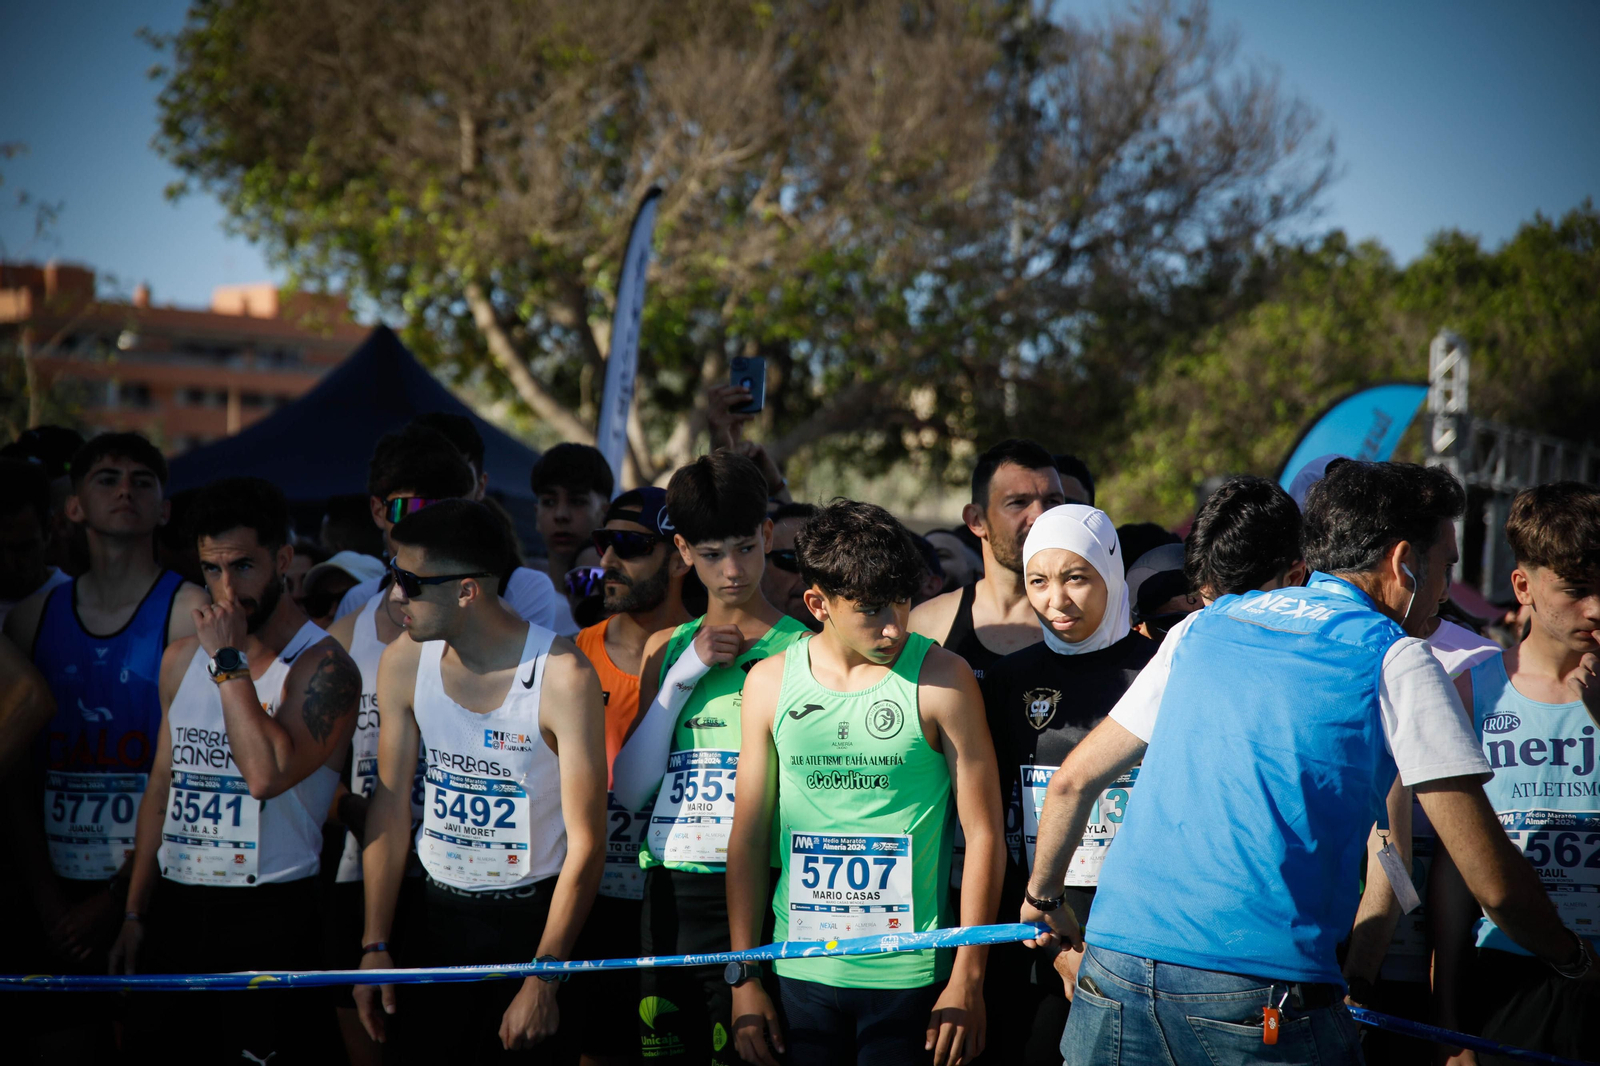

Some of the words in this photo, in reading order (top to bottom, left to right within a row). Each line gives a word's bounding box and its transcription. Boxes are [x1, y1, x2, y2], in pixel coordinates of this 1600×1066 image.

[1241, 593, 1337, 620] NEXAL
[1031, 700, 1050, 713] CD
[1484, 716, 1519, 731] TROPS
[484, 729, 532, 748] ENTRENA
[1487, 725, 1600, 776] nerj
[703, 757, 722, 765] 2024
[806, 756, 843, 766] ATLETISMO
[846, 753, 867, 766] BAHÍA
[868, 753, 903, 766] ALMERÍA
[204, 780, 221, 789] 2024
[806, 769, 889, 789] eCoCulture
[470, 783, 488, 792] 2024
[1512, 781, 1600, 798] ATLETISM
[51, 793, 134, 824] 5770
[171, 790, 242, 827] 5541
[433, 787, 517, 829] 5492
[688, 803, 713, 812] MARIO
[1525, 811, 1546, 819] Medio
[1547, 811, 1577, 821] Maratón
[1525, 818, 1555, 827] Almería
[1555, 818, 1578, 827] 2024
[68, 824, 105, 834] JUANLU
[213, 826, 218, 835] S
[444, 822, 461, 832] JAVI
[463, 826, 496, 838] MORET
[608, 812, 650, 843] 27
[823, 837, 840, 845] Medio
[823, 843, 846, 851] Almería
[847, 843, 867, 851] 2024
[802, 855, 898, 891] 5707
[1537, 868, 1567, 878] RAUL
[813, 890, 842, 900] MARIO
[846, 891, 881, 901] CASAS
[820, 921, 838, 930] NEXAL
[641, 1032, 680, 1047] Unicaja
